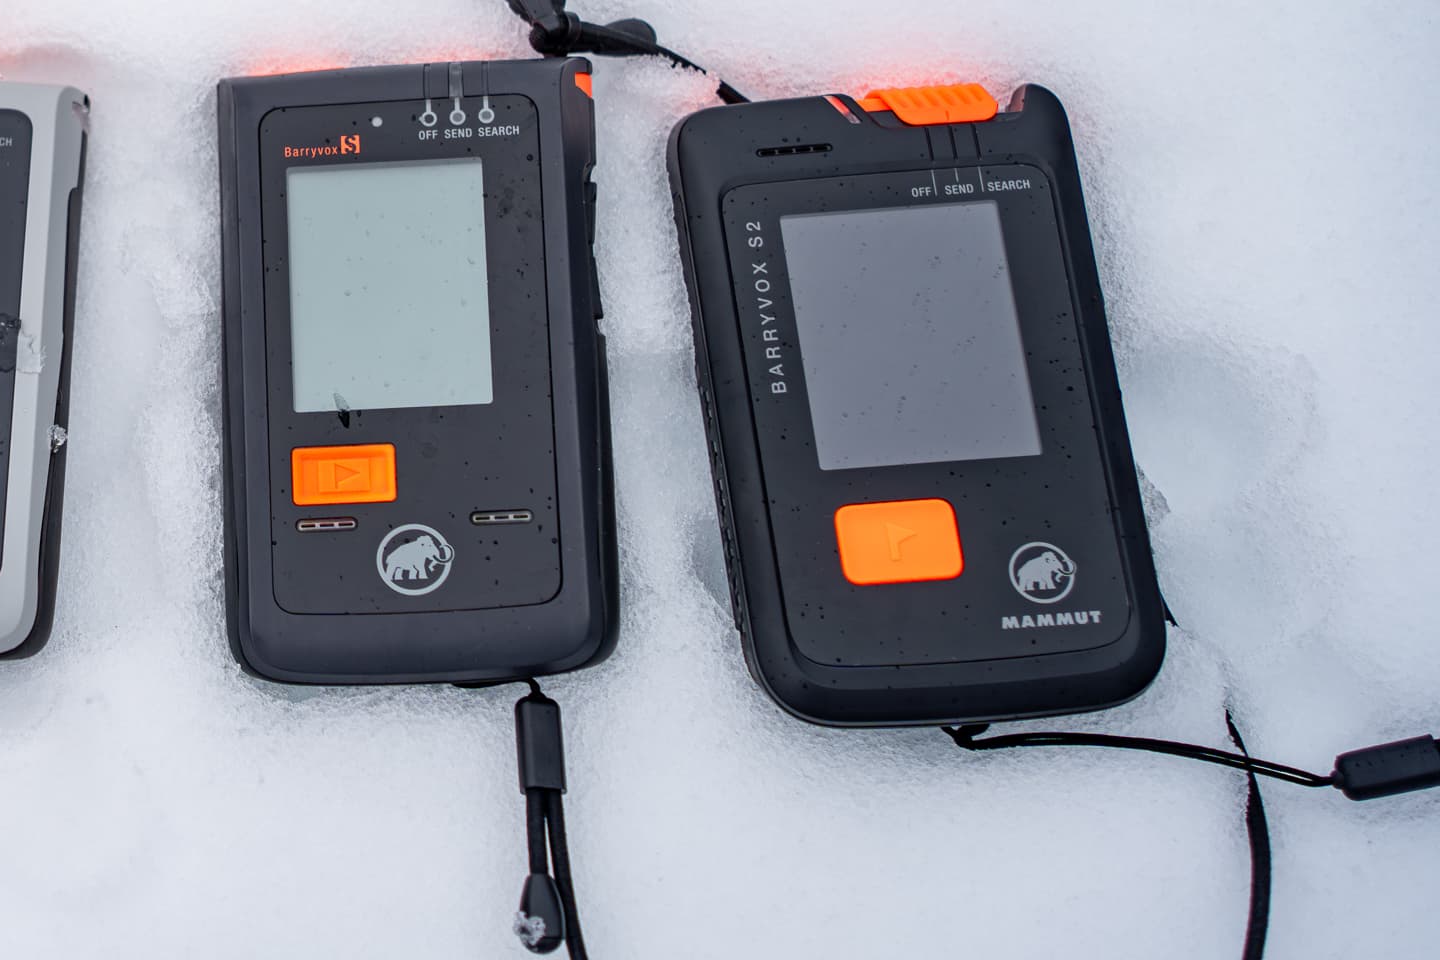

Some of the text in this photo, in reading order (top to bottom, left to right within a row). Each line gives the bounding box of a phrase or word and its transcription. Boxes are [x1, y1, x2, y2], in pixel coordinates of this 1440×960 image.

[418, 125, 520, 141] OFF SEND SEARCH
[284, 145, 338, 159] Barryvox
[911, 179, 1031, 198] OFF SEND SEARCH
[745, 221, 787, 394] BARRYVOX S2
[1001, 610, 1102, 630] MAMMUT
